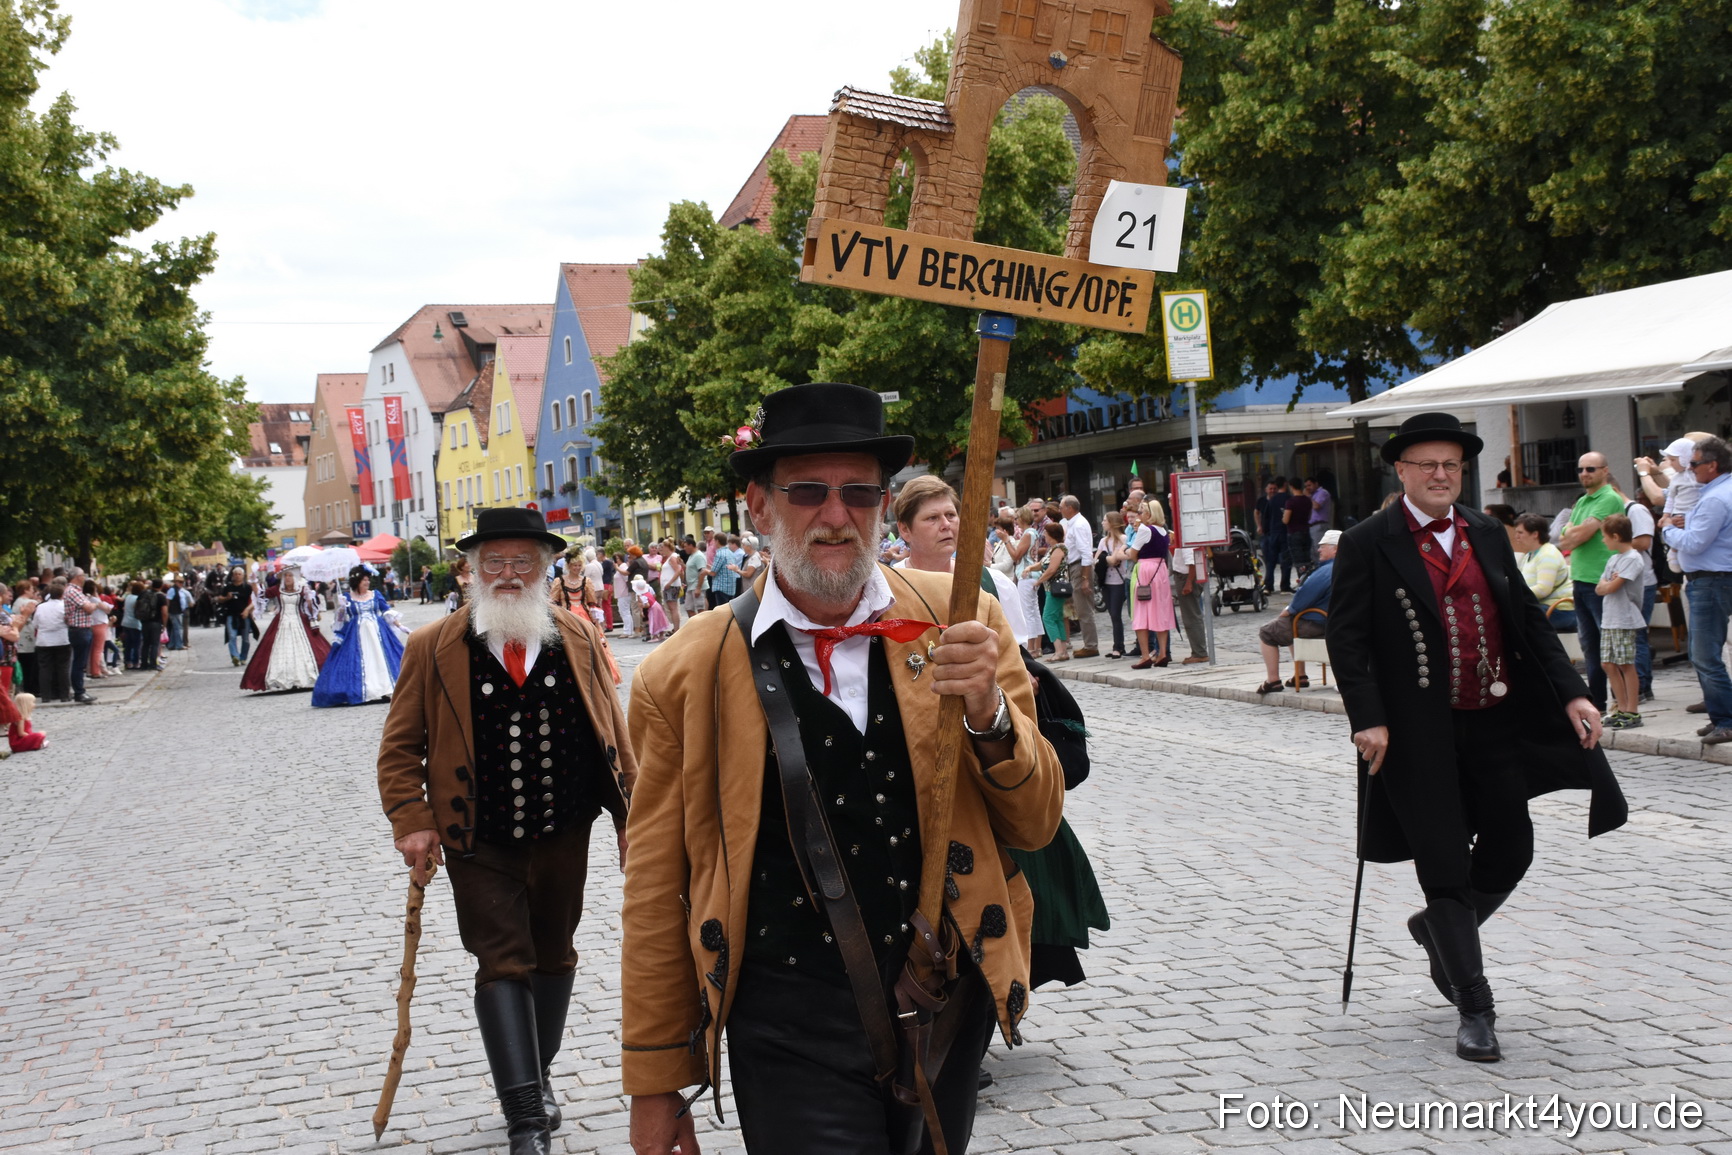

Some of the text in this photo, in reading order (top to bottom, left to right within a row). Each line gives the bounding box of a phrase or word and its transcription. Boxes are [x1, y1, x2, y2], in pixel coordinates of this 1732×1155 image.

[1115, 211, 1157, 251] 21
[831, 230, 909, 280] VTV
[1177, 305, 1194, 325] H
[1174, 334, 1201, 342] Marktplatz
[386, 399, 397, 425] K&L
[1036, 394, 1171, 442] ANTON PETER
